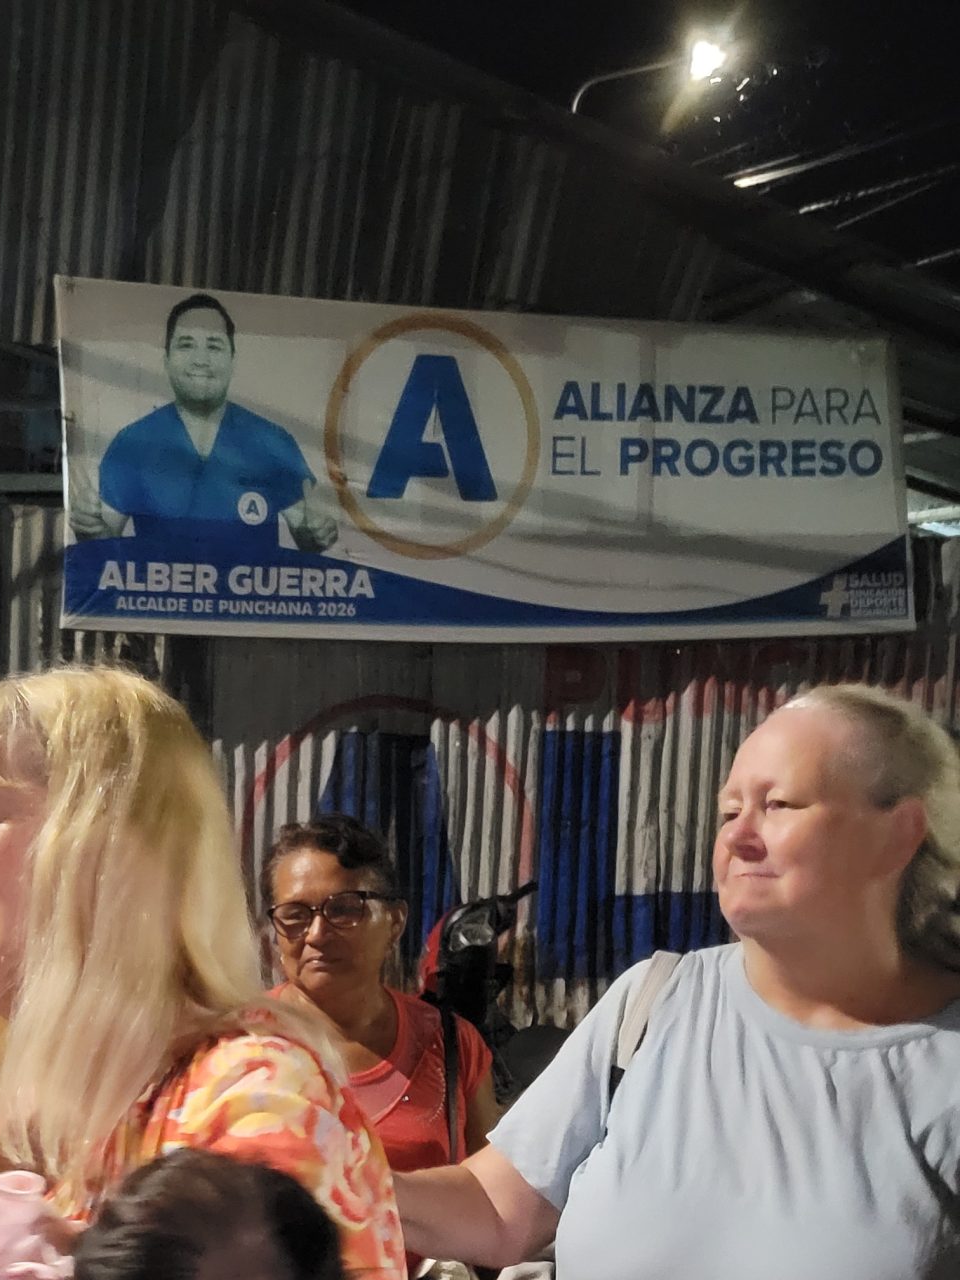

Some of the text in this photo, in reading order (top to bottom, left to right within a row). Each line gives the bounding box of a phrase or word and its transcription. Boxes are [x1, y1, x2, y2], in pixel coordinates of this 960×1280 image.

[553, 380, 882, 425] ALIANZA PARA
[366, 354, 498, 502] A
[551, 436, 884, 478] EL PROGRESO
[98, 560, 375, 599] ALBER GUERRA
[848, 571, 905, 588] SALUD
[115, 595, 357, 617] ALCALDE DE PUNCHANA 2026
